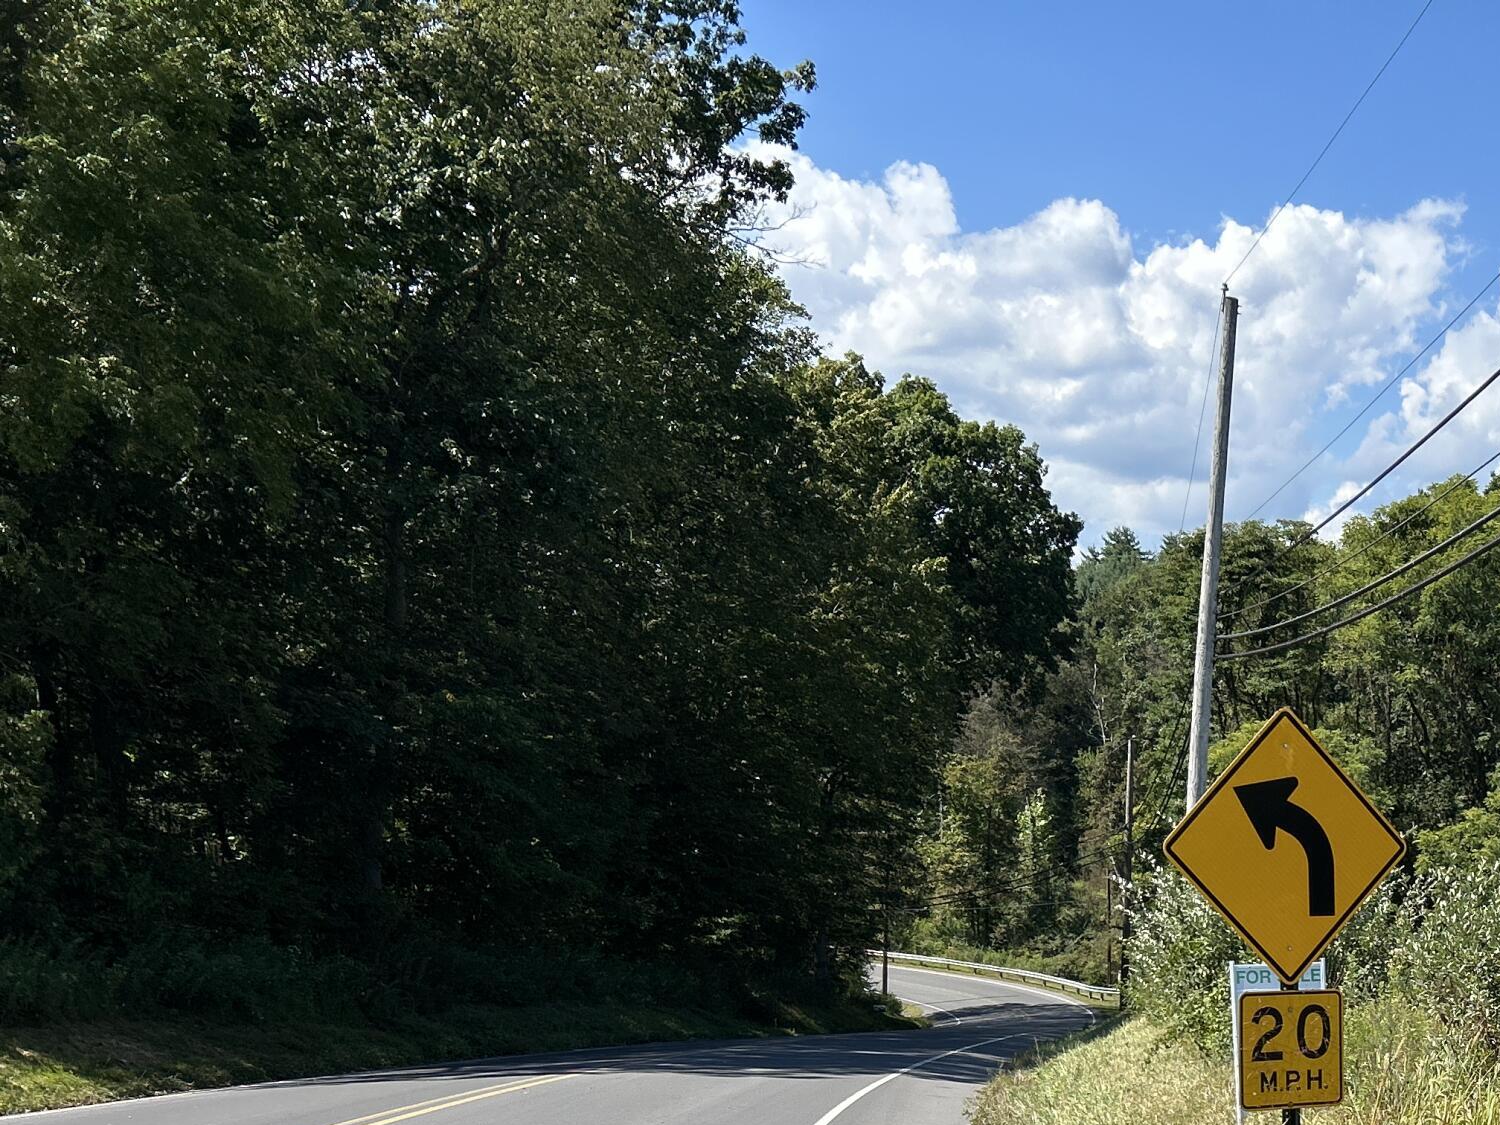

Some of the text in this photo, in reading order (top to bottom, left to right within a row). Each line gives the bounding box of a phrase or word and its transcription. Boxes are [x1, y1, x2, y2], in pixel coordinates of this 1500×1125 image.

[1236, 968, 1321, 984] FOR LE
[1251, 1004, 1331, 1062] 20
